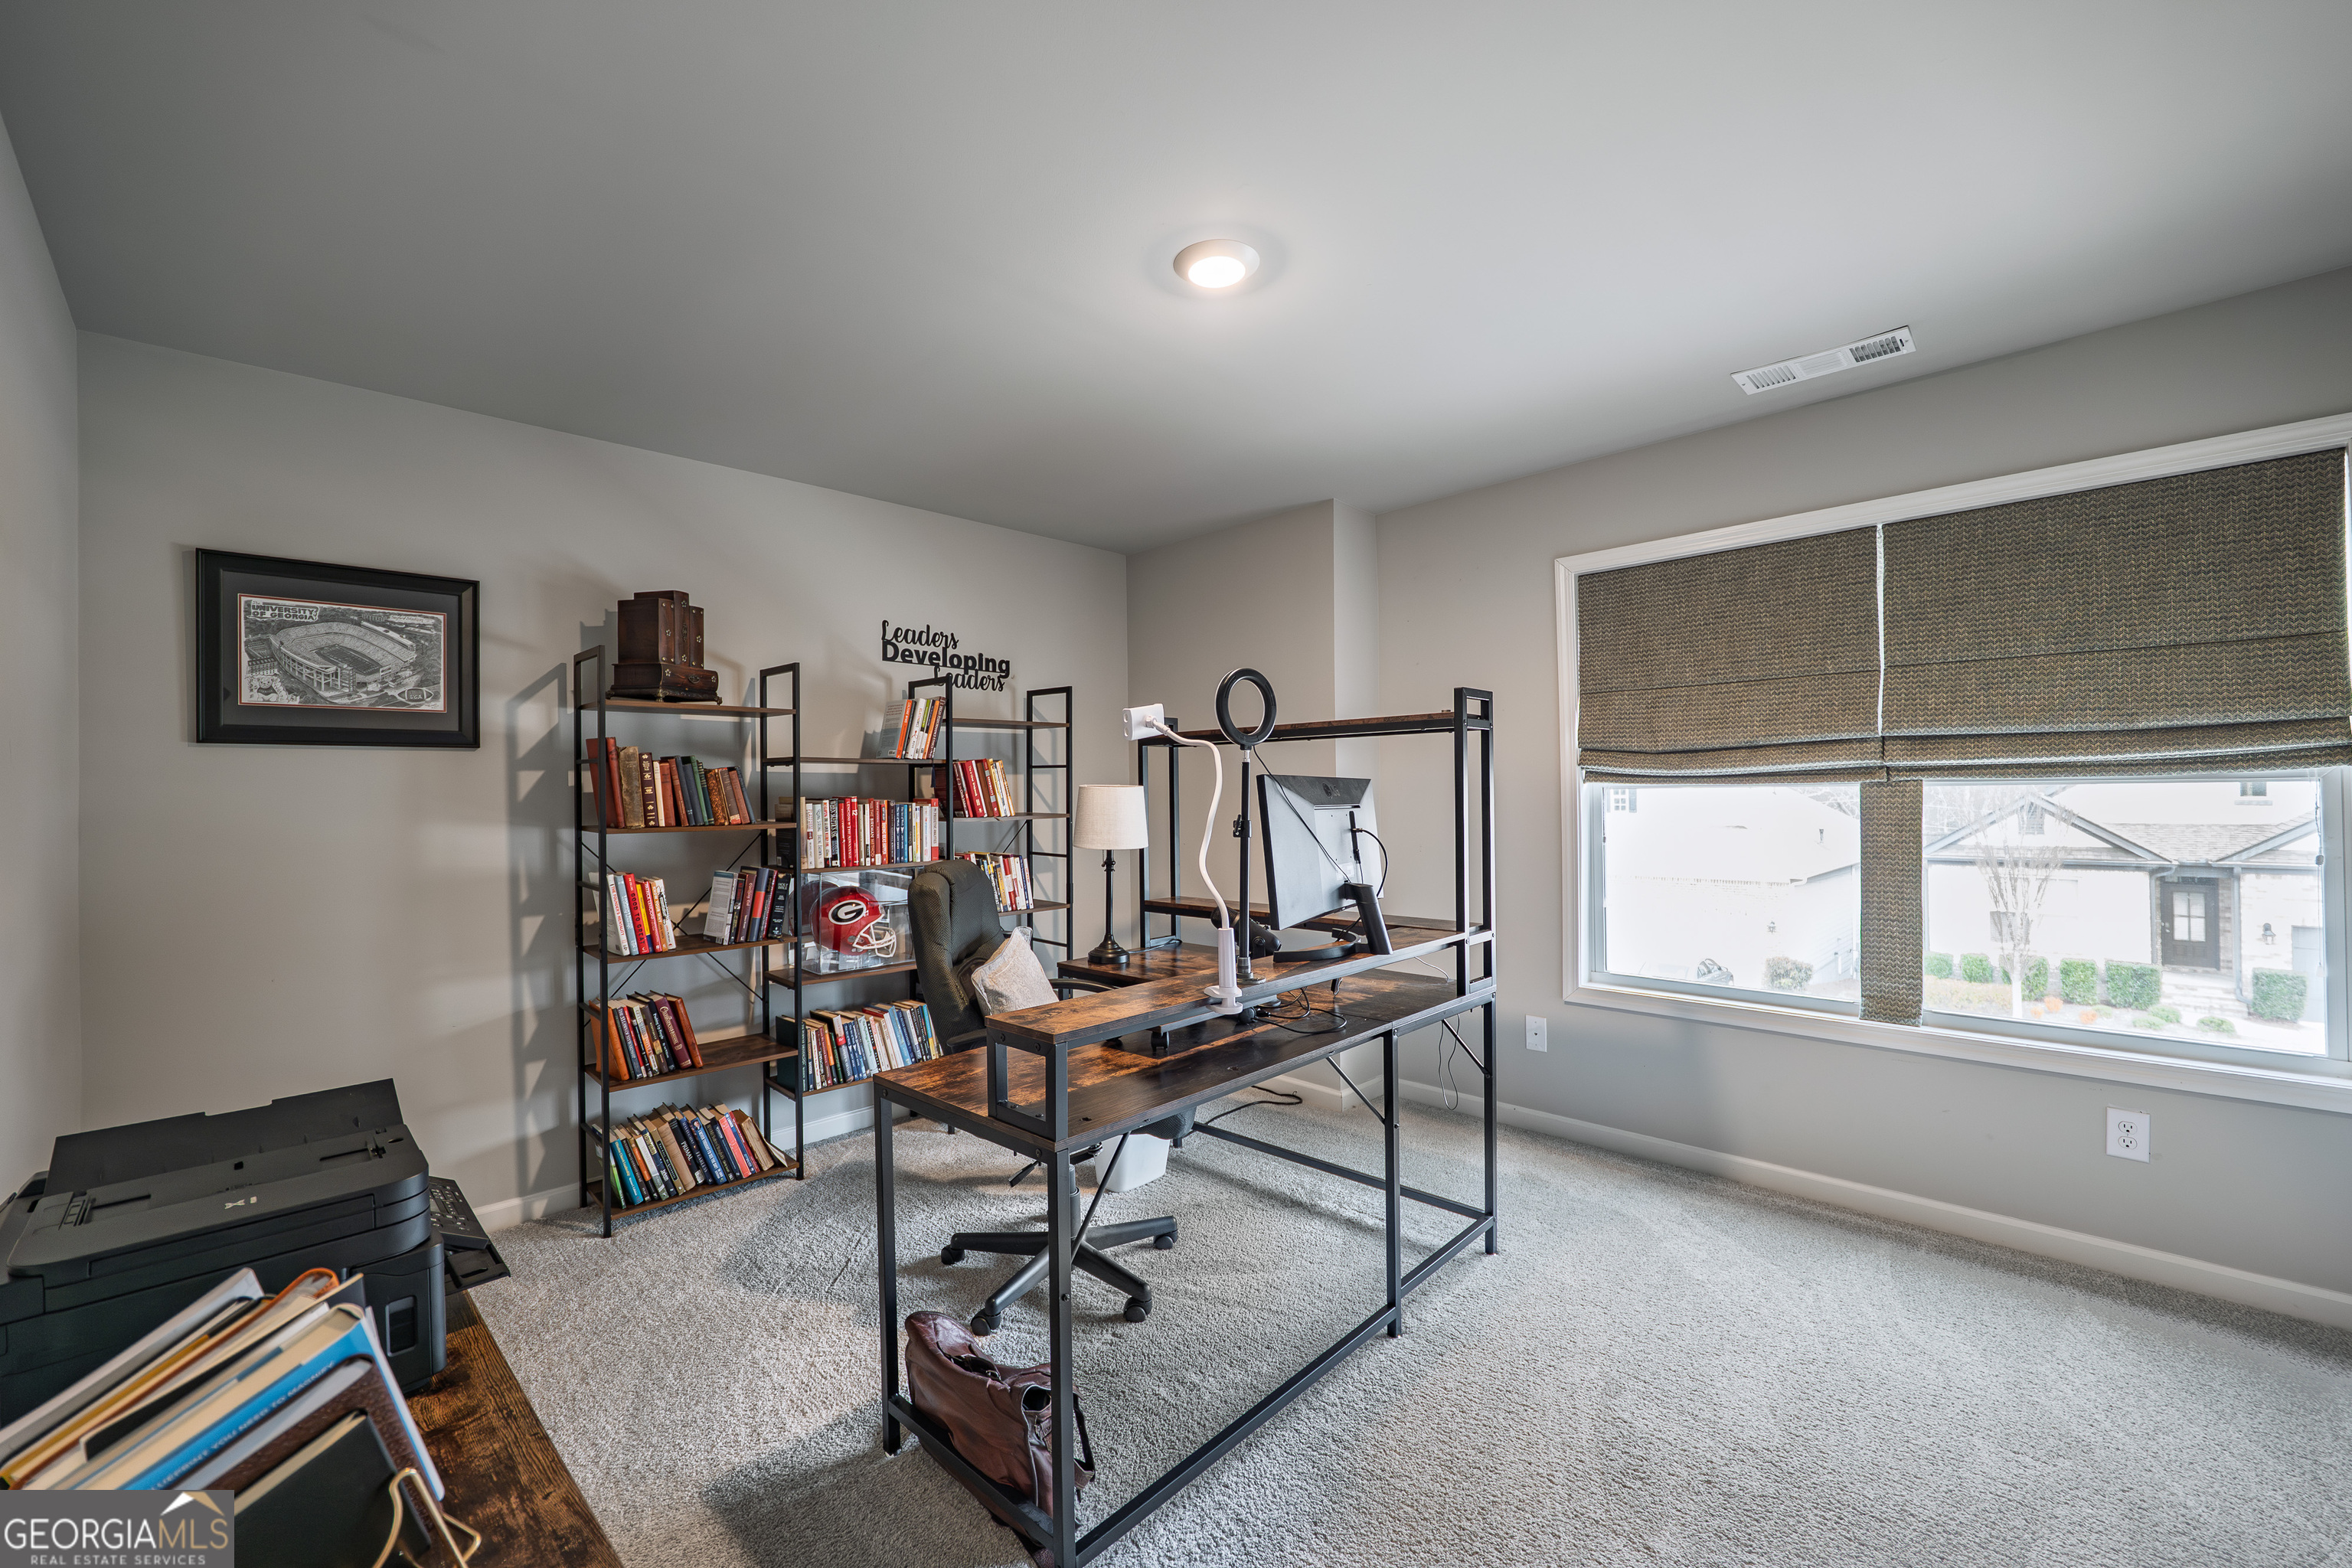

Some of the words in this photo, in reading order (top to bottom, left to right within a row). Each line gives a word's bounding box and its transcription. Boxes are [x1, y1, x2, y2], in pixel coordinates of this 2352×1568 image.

[252, 605, 314, 615] UNIVERSITY
[270, 612, 315, 621] GEORGIA
[881, 619, 959, 650] Leaders
[882, 640, 1010, 679] Developing
[933, 665, 1005, 692] Laders
[634, 913, 640, 921] TO
[636, 923, 645, 944] GREAT
[680, 1140, 693, 1161] PRIMAL
[272, 1396, 286, 1408] TO
